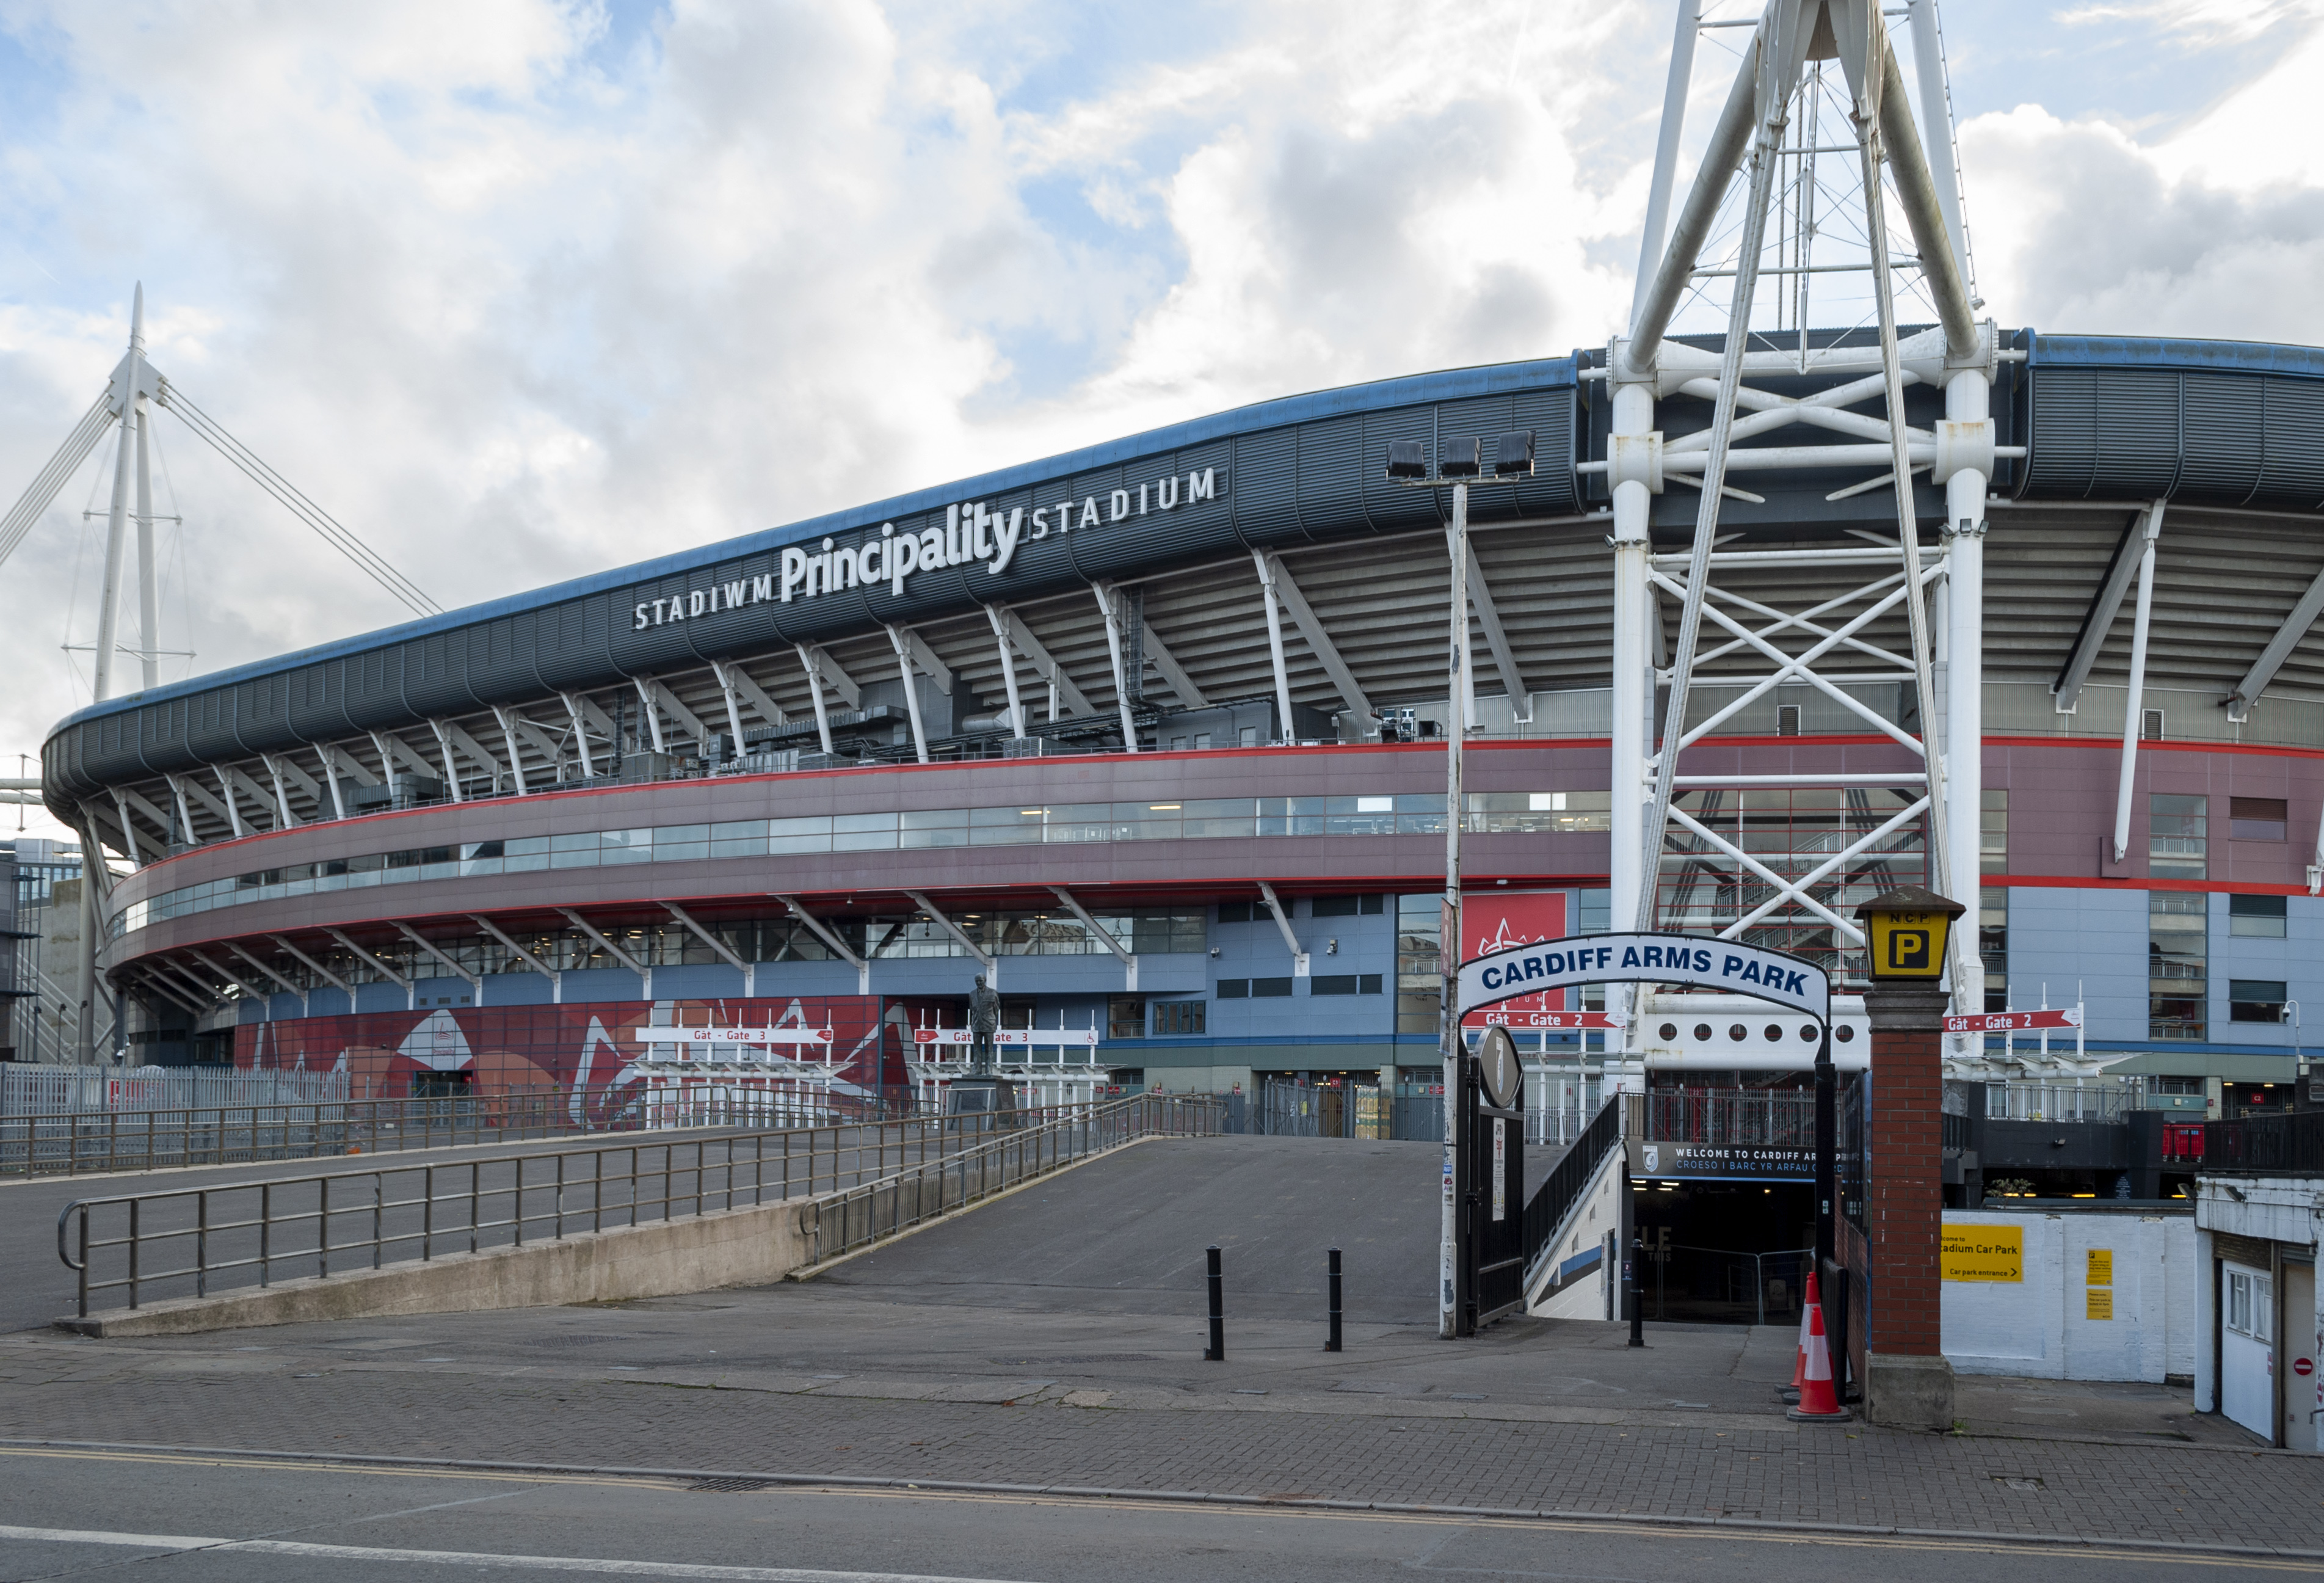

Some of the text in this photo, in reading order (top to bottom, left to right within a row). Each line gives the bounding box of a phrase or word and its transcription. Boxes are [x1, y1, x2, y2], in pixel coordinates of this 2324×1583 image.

[634, 467, 1215, 630] STADIWM Principality STADIUM
[1890, 914, 1928, 923] NCP
[1896, 934, 1922, 965] P
[1481, 945, 1810, 997] CARDIFF ARMS PARK
[1486, 1013, 1509, 1025] Gât
[1530, 1013, 1561, 1026] Gate
[1574, 1014, 1583, 1026] 2
[1948, 1018, 1968, 1031] Gât
[1986, 1016, 2013, 1029] Gate
[2024, 1014, 2032, 1027] 2
[694, 1030, 711, 1039] Gât
[727, 1031, 750, 1040] Gate
[760, 1031, 765, 1040] 3
[954, 1032, 1028, 1042] Gât ate 3
[1676, 1149, 1730, 1159] WELCOME
[1754, 1151, 1799, 1160] CARDIFF
[1804, 1152, 1816, 1161] AR
[1676, 1160, 1718, 1170] CROESO
[1730, 1162, 1756, 1171] BARC
[1761, 1162, 1772, 1171] YR
[1776, 1163, 1808, 1172] ARFAU
[1976, 1245, 1993, 1254] Car
[1995, 1245, 2017, 1254] Park
